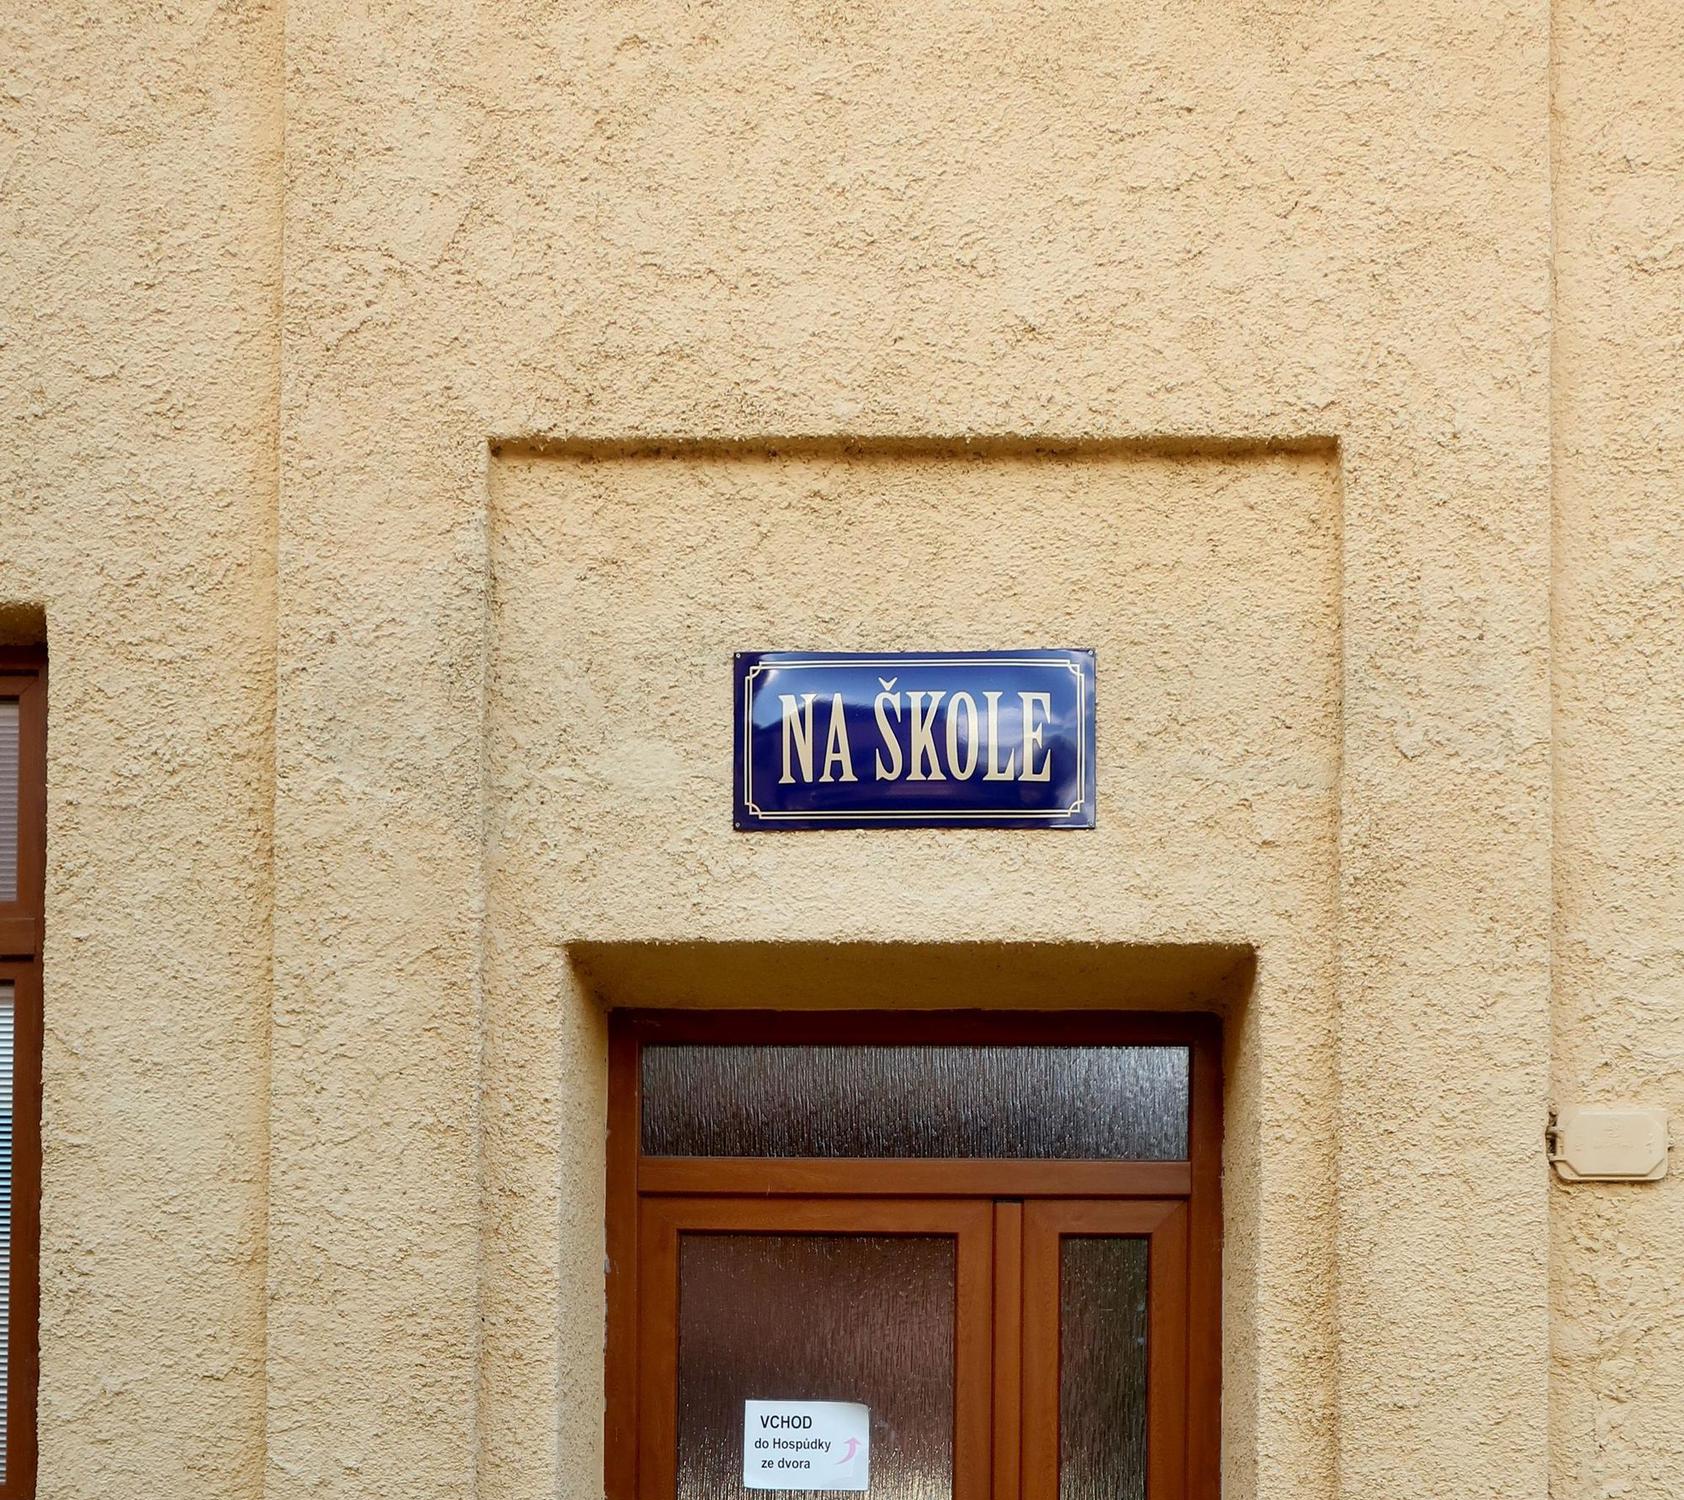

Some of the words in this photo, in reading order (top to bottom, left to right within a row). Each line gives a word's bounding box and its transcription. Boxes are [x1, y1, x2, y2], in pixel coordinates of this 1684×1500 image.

[778, 693, 858, 784] NA
[874, 676, 1052, 782] ŠKOLE
[760, 1415, 812, 1429] VCHOD
[754, 1437, 769, 1449] do
[761, 1459, 774, 1469] ze
[777, 1457, 811, 1469] dvora
